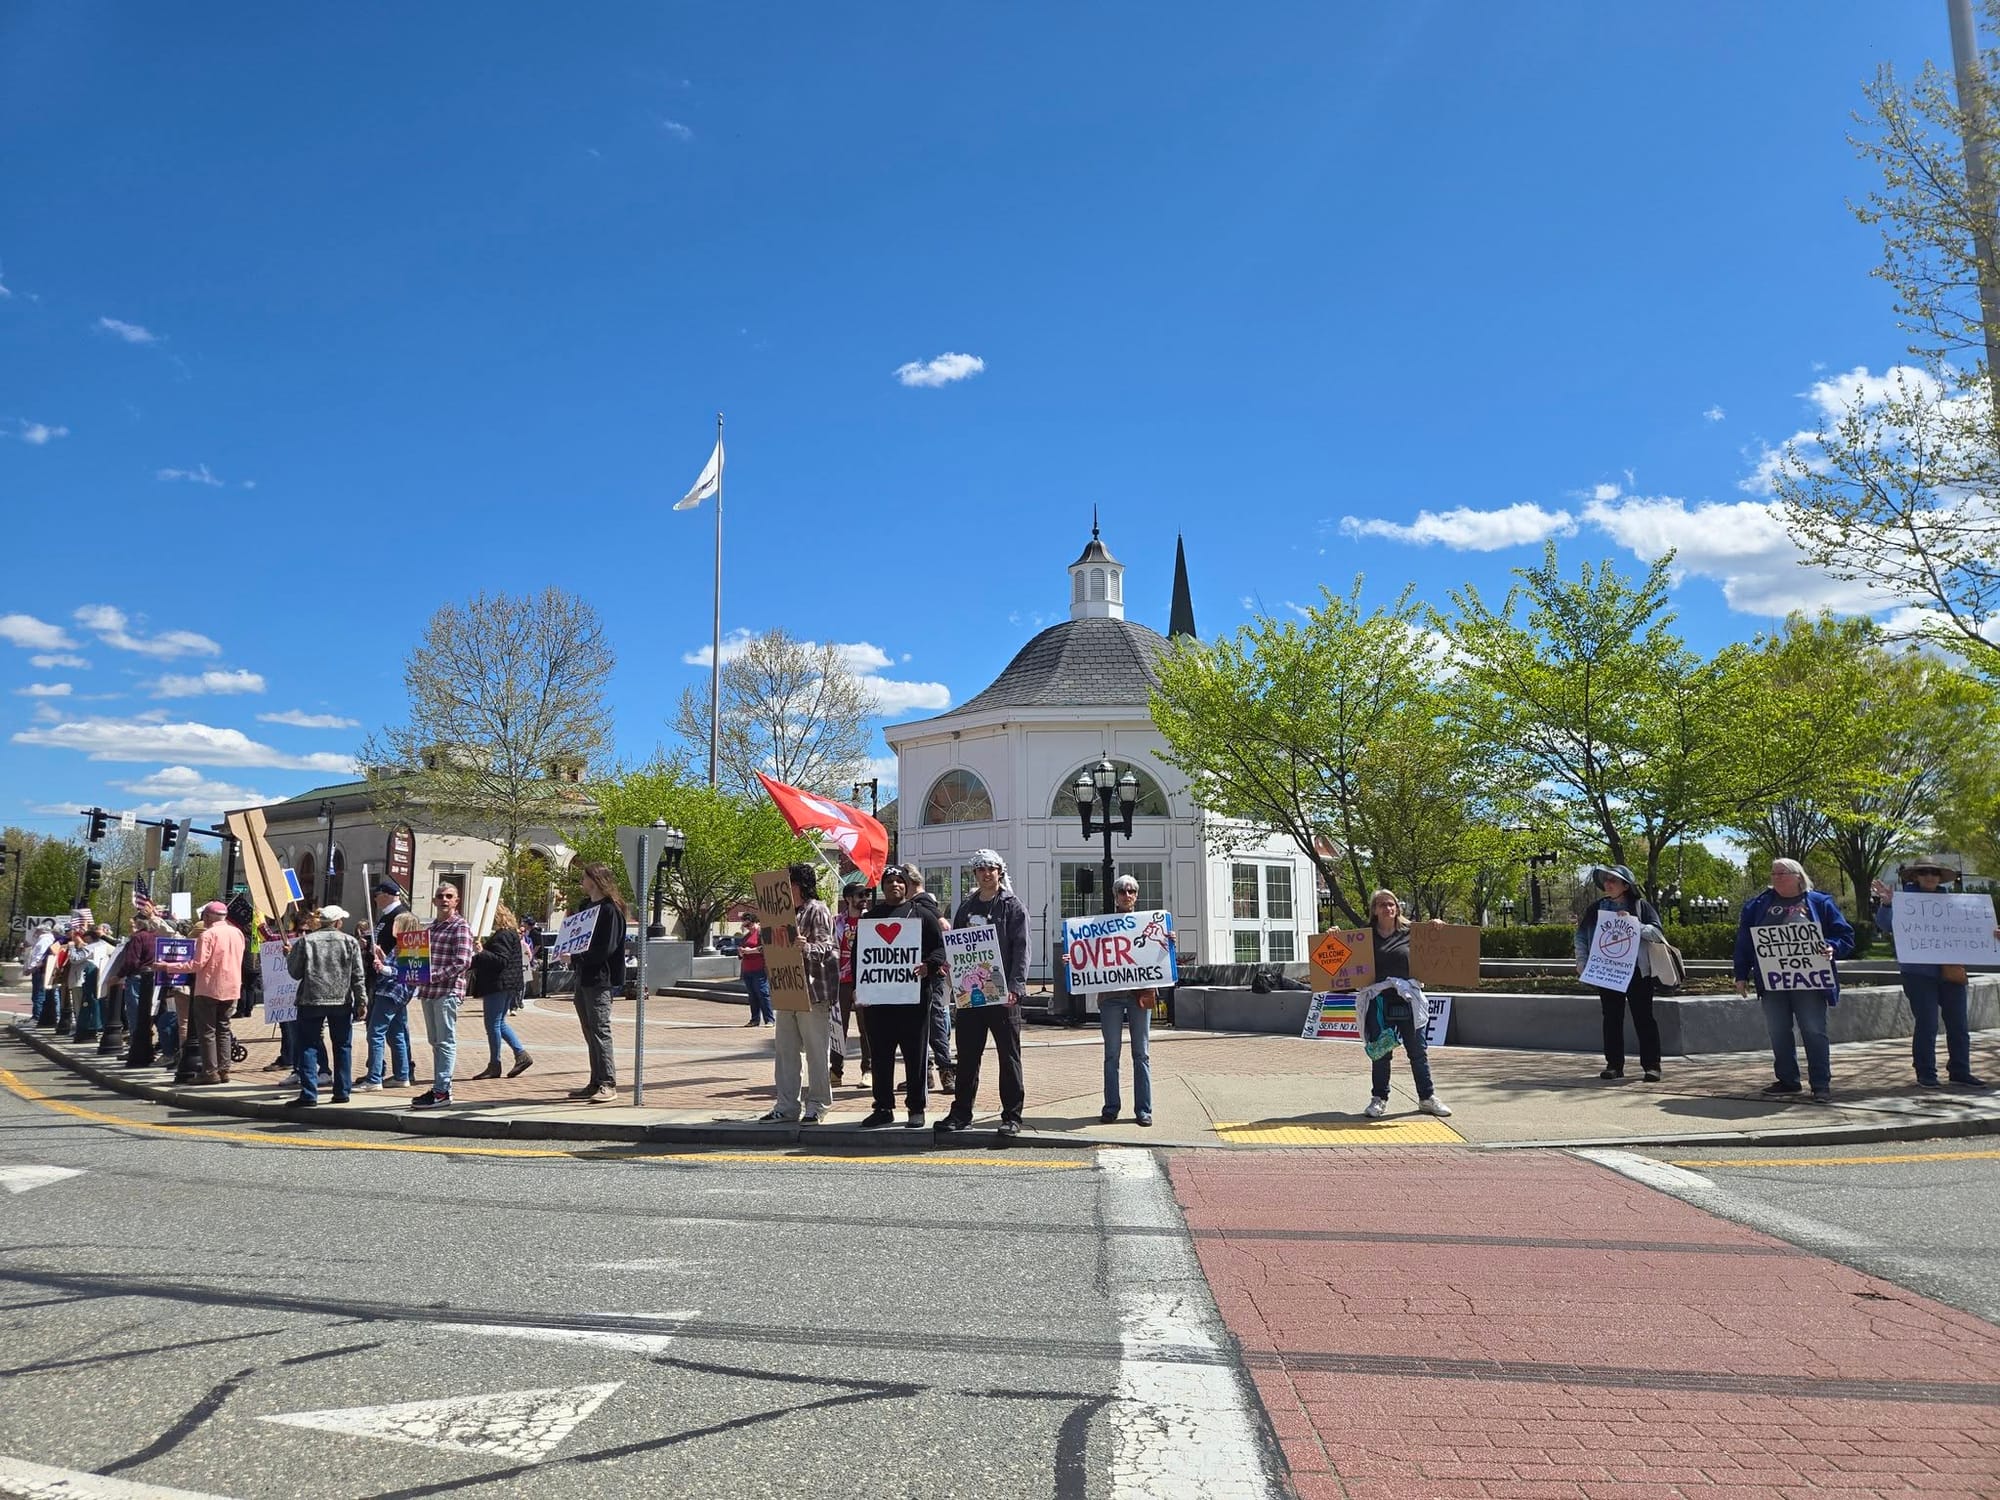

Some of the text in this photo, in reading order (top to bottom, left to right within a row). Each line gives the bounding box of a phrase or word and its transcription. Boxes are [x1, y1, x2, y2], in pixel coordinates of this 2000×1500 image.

[1904, 897, 1992, 920] STOP ICE
[1071, 917, 1136, 938] WORKERS
[1758, 924, 1821, 944] SENIOR
[403, 932, 425, 946] COME
[945, 929, 994, 946] PRESIDENT
[1346, 932, 1365, 944] NO
[862, 947, 919, 965] STUDENT
[966, 944, 977, 952] OF
[1070, 936, 1137, 970] OVER
[1318, 949, 1345, 959] WELCOME
[1757, 941, 1825, 958] CITIZENS
[953, 950, 994, 965] PROFITS
[1779, 958, 1813, 969] FOR
[860, 968, 918, 984] ACTIVISM
[1072, 966, 1163, 986] BILLIONAIRES
[1330, 977, 1352, 988] ICE
[1768, 970, 1834, 989] PEACE
[1429, 1000, 1446, 1014] GHT
